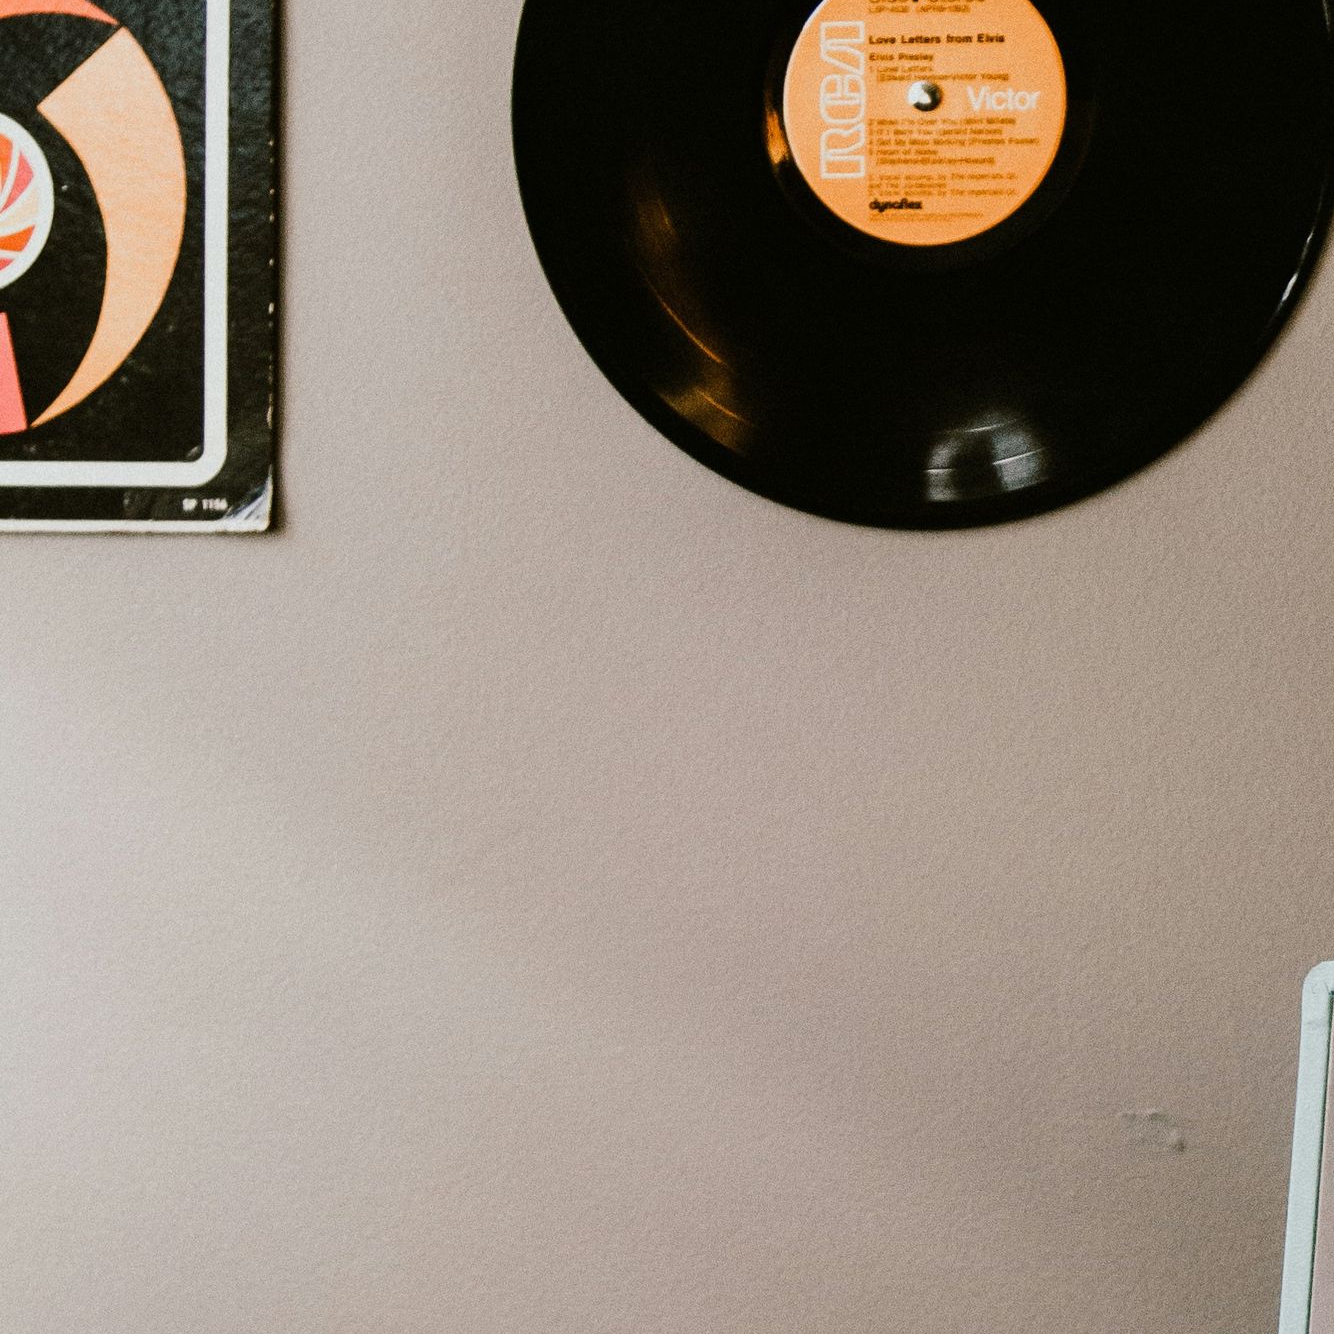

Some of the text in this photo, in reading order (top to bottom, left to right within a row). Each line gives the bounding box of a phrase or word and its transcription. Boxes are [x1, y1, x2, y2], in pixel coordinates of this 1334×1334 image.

[868, 33, 1005, 44] Love Letters from Elvis
[868, 52, 934, 62] Elvis Presley
[820, 21, 865, 179] RCA
[967, 85, 1041, 111] Victor
